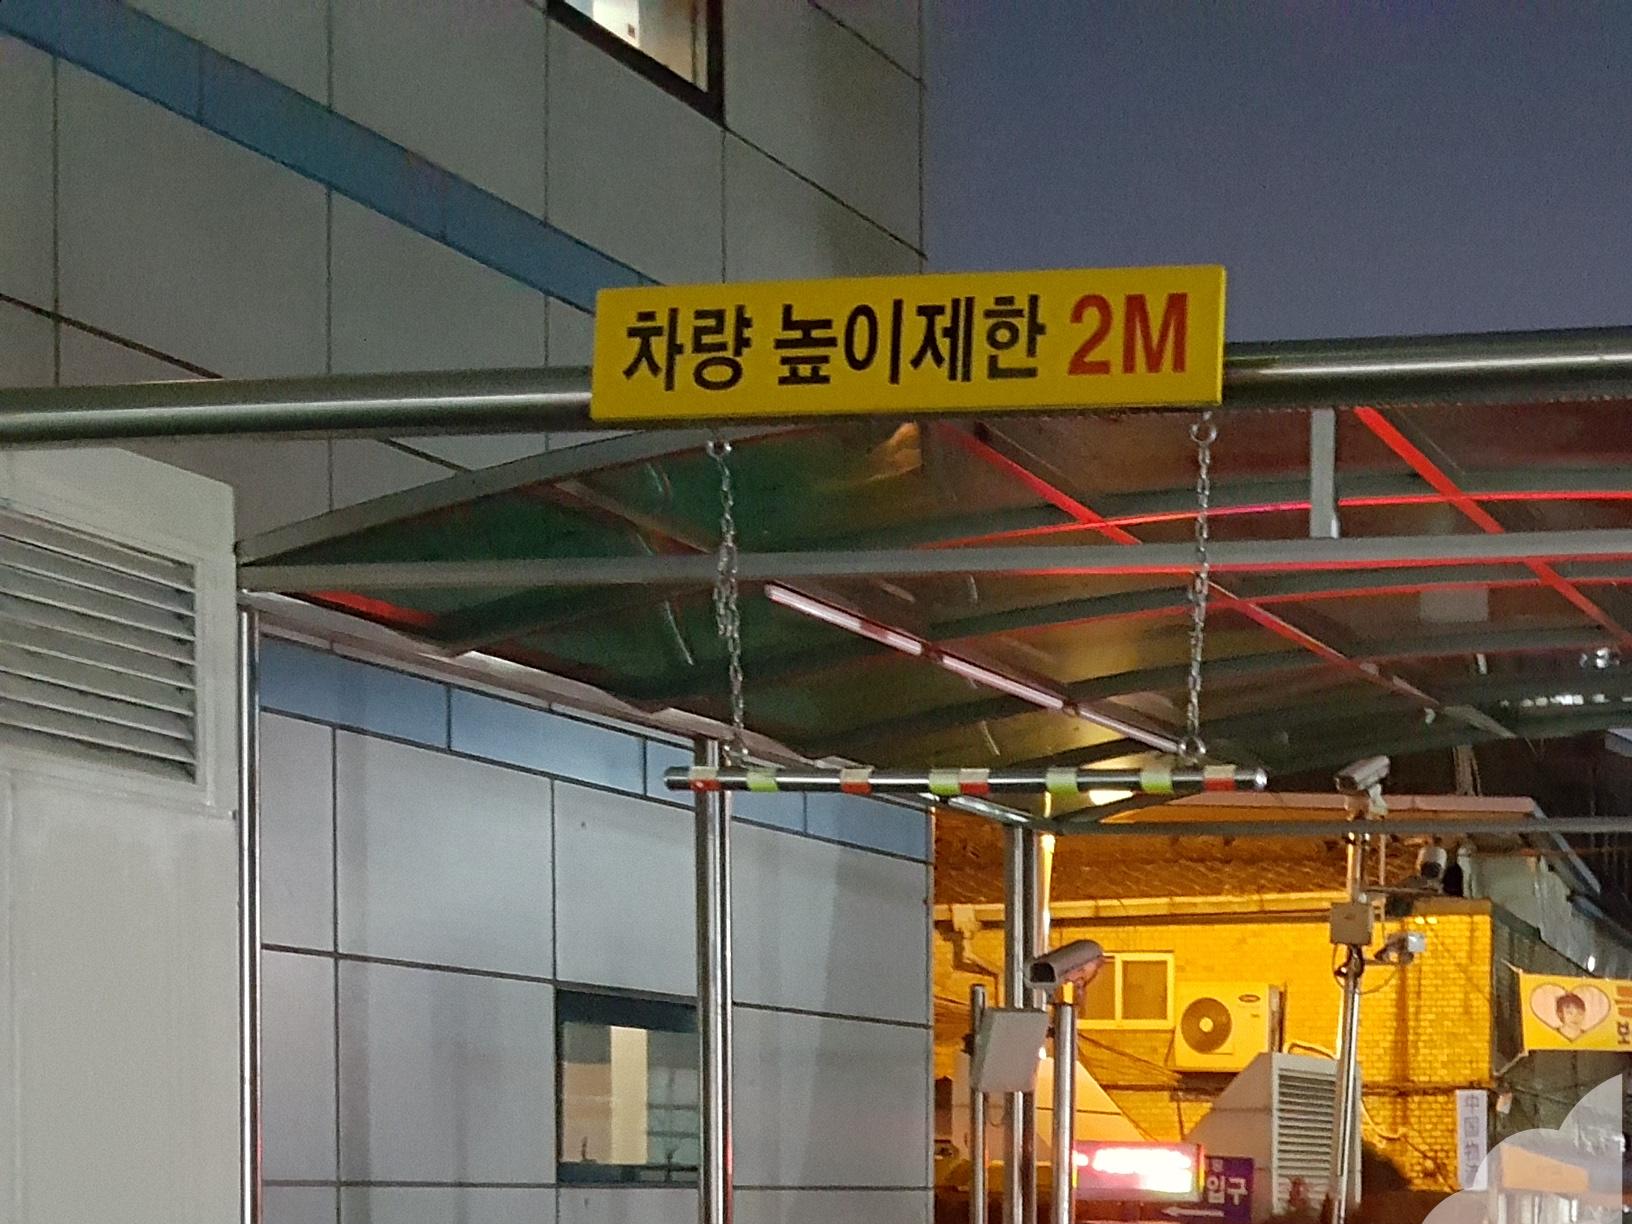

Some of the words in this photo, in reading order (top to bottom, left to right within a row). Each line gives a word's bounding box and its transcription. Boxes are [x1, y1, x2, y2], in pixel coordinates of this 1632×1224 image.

[621, 303, 754, 393] 차량
[772, 292, 1047, 388] 높이제한
[1066, 291, 1190, 378] 2M
[1206, 1174, 1248, 1206] 입구
